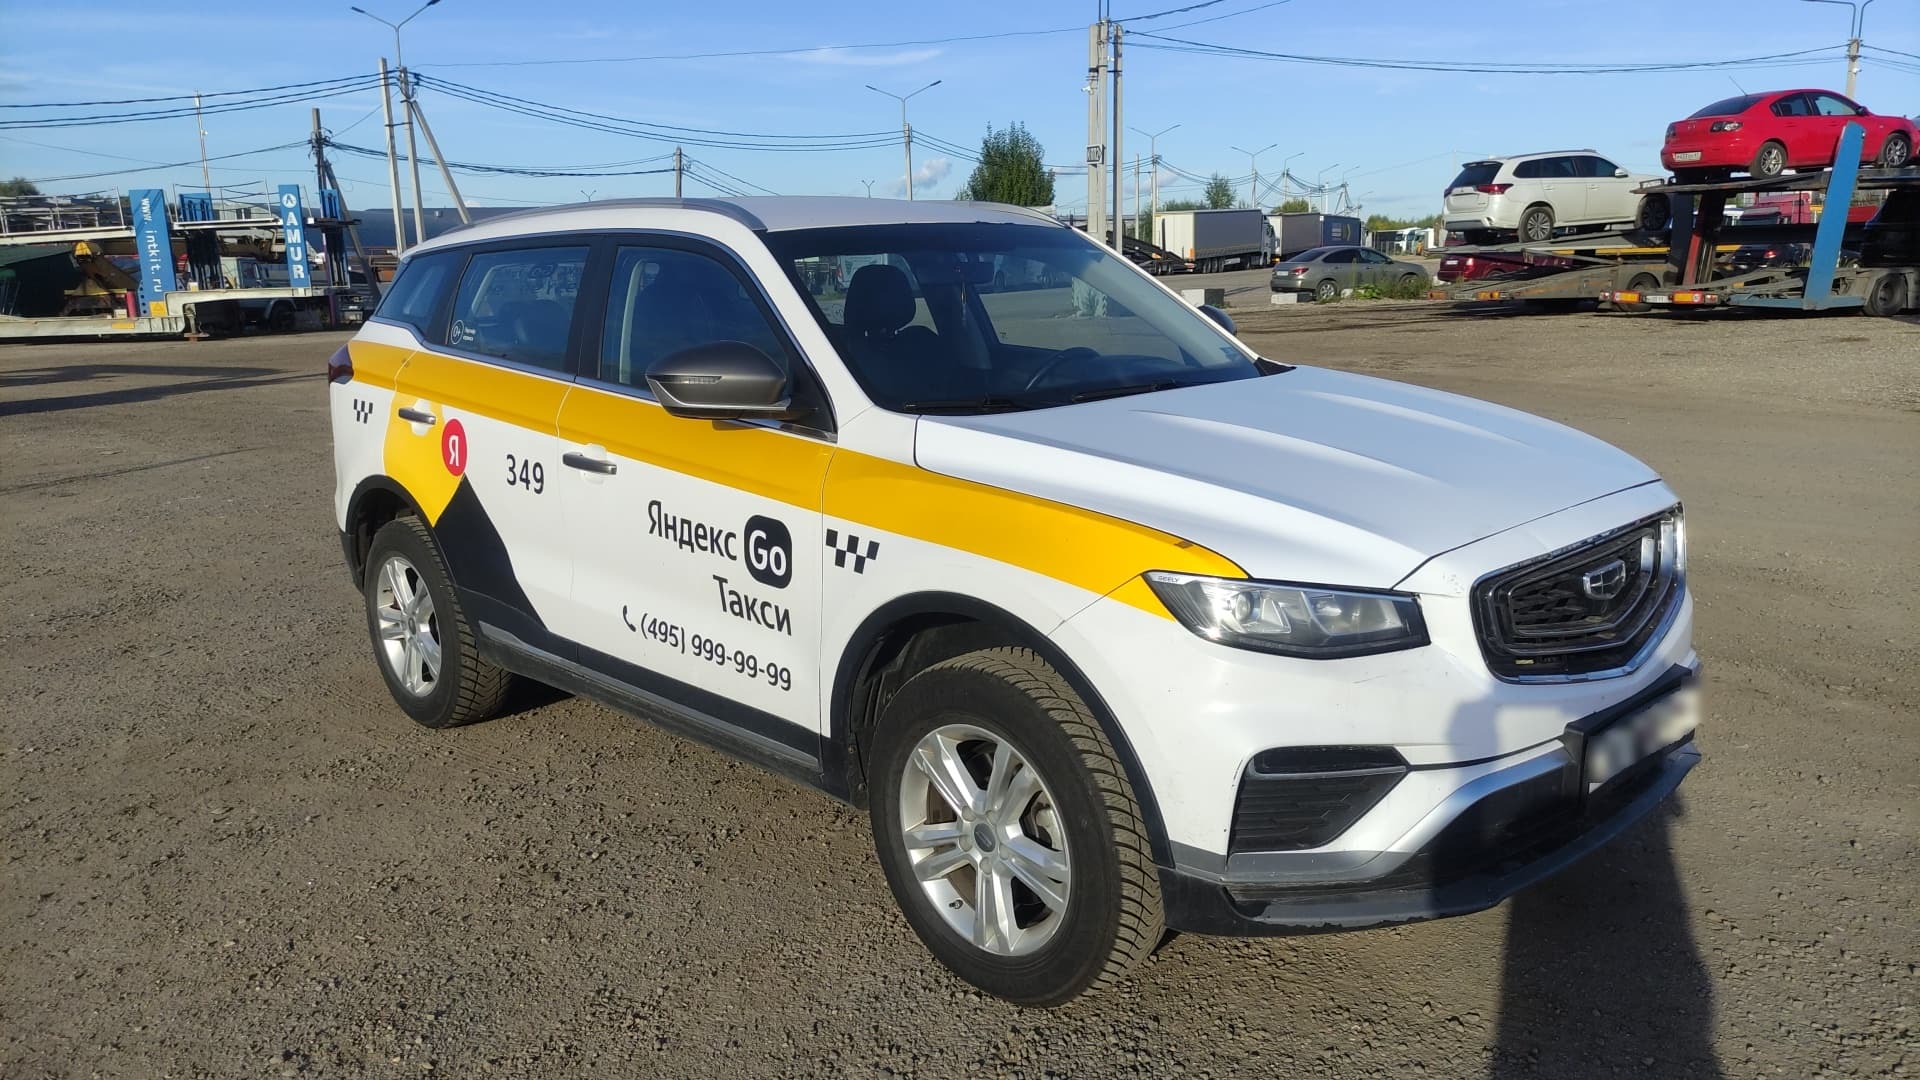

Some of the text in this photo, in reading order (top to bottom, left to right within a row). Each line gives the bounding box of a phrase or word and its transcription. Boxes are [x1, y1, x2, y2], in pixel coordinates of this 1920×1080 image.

[286, 211, 305, 279] AMUR
[448, 434, 460, 467] Я
[506, 453, 544, 495] 349
[647, 499, 787, 577] Яндекс Go
[712, 574, 792, 636] Такси
[640, 612, 792, 692] (495) 999-99-99
